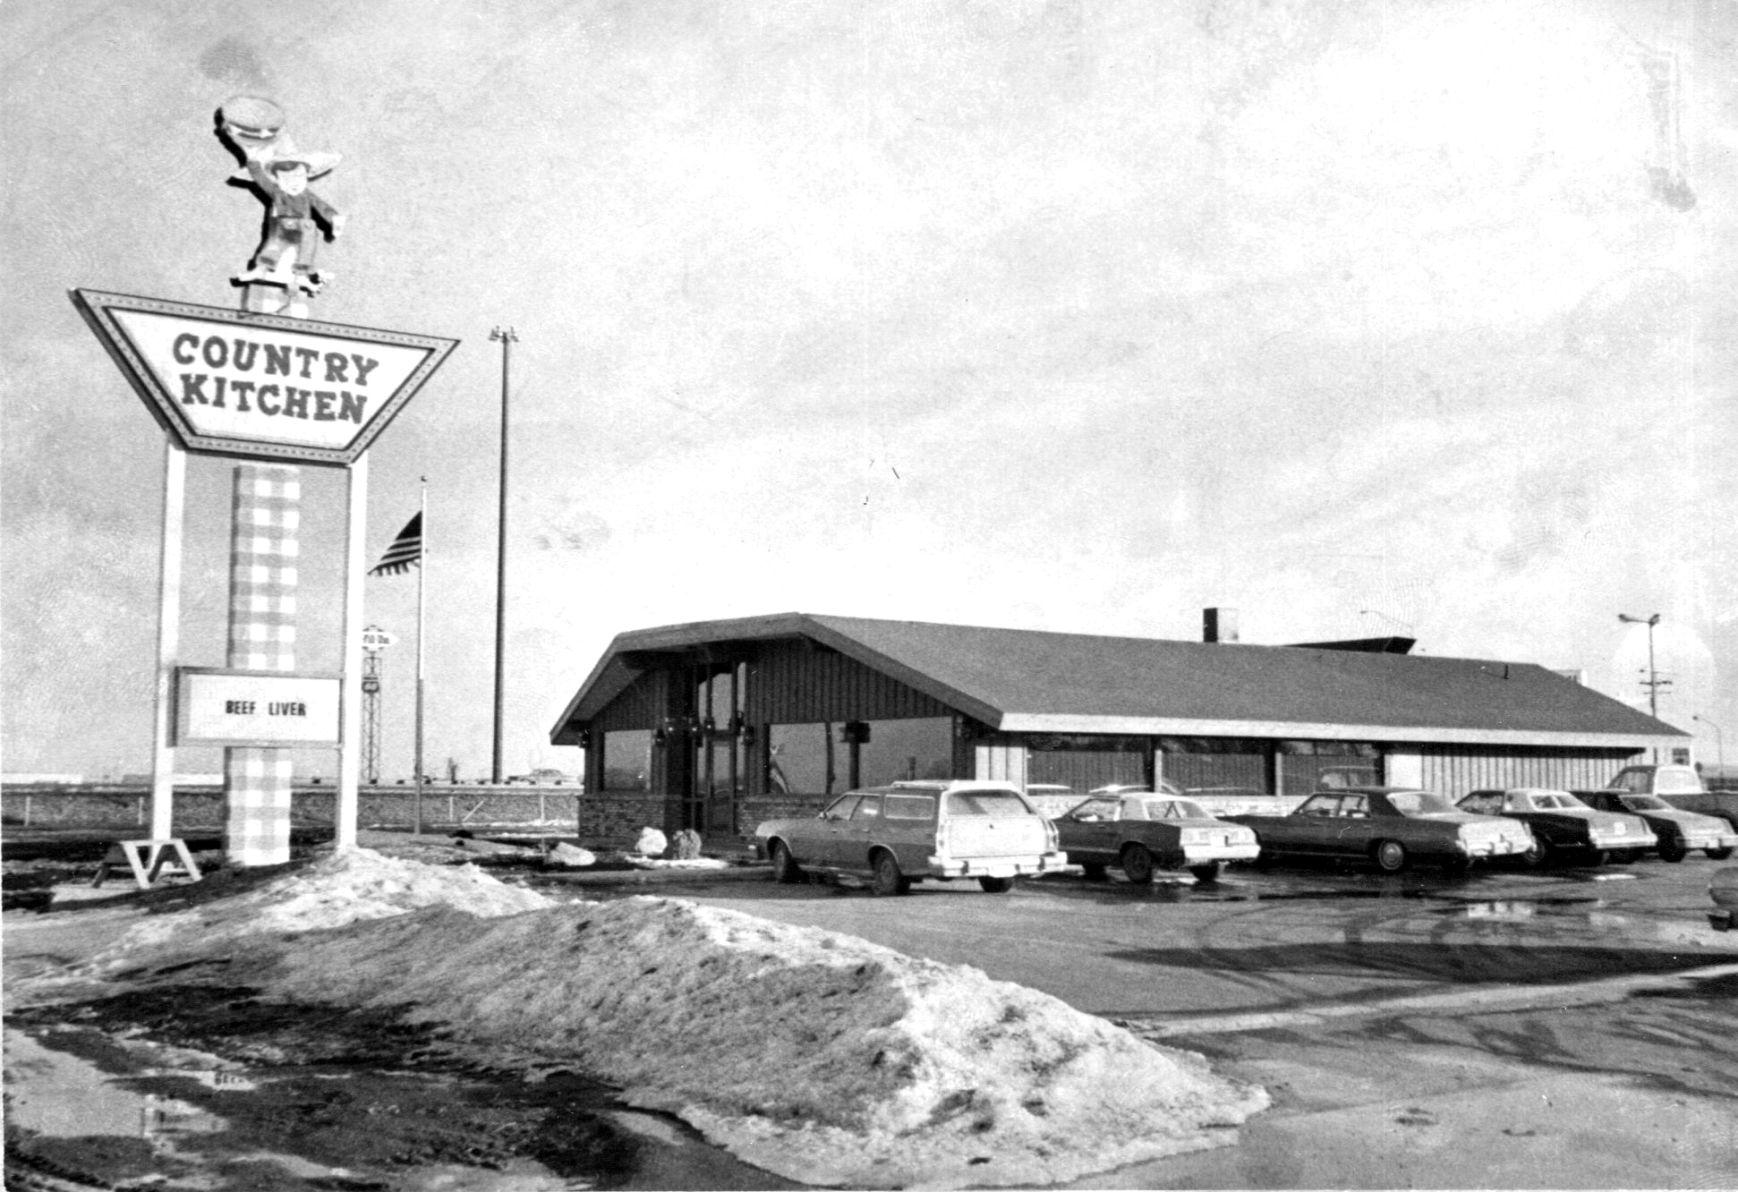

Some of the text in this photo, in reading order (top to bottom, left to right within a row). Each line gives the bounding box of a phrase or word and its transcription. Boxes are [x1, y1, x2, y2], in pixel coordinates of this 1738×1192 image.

[173, 333, 379, 385] COUNTRY
[180, 373, 367, 424] KITCHEN
[225, 700, 306, 716] BEEF LIVER
